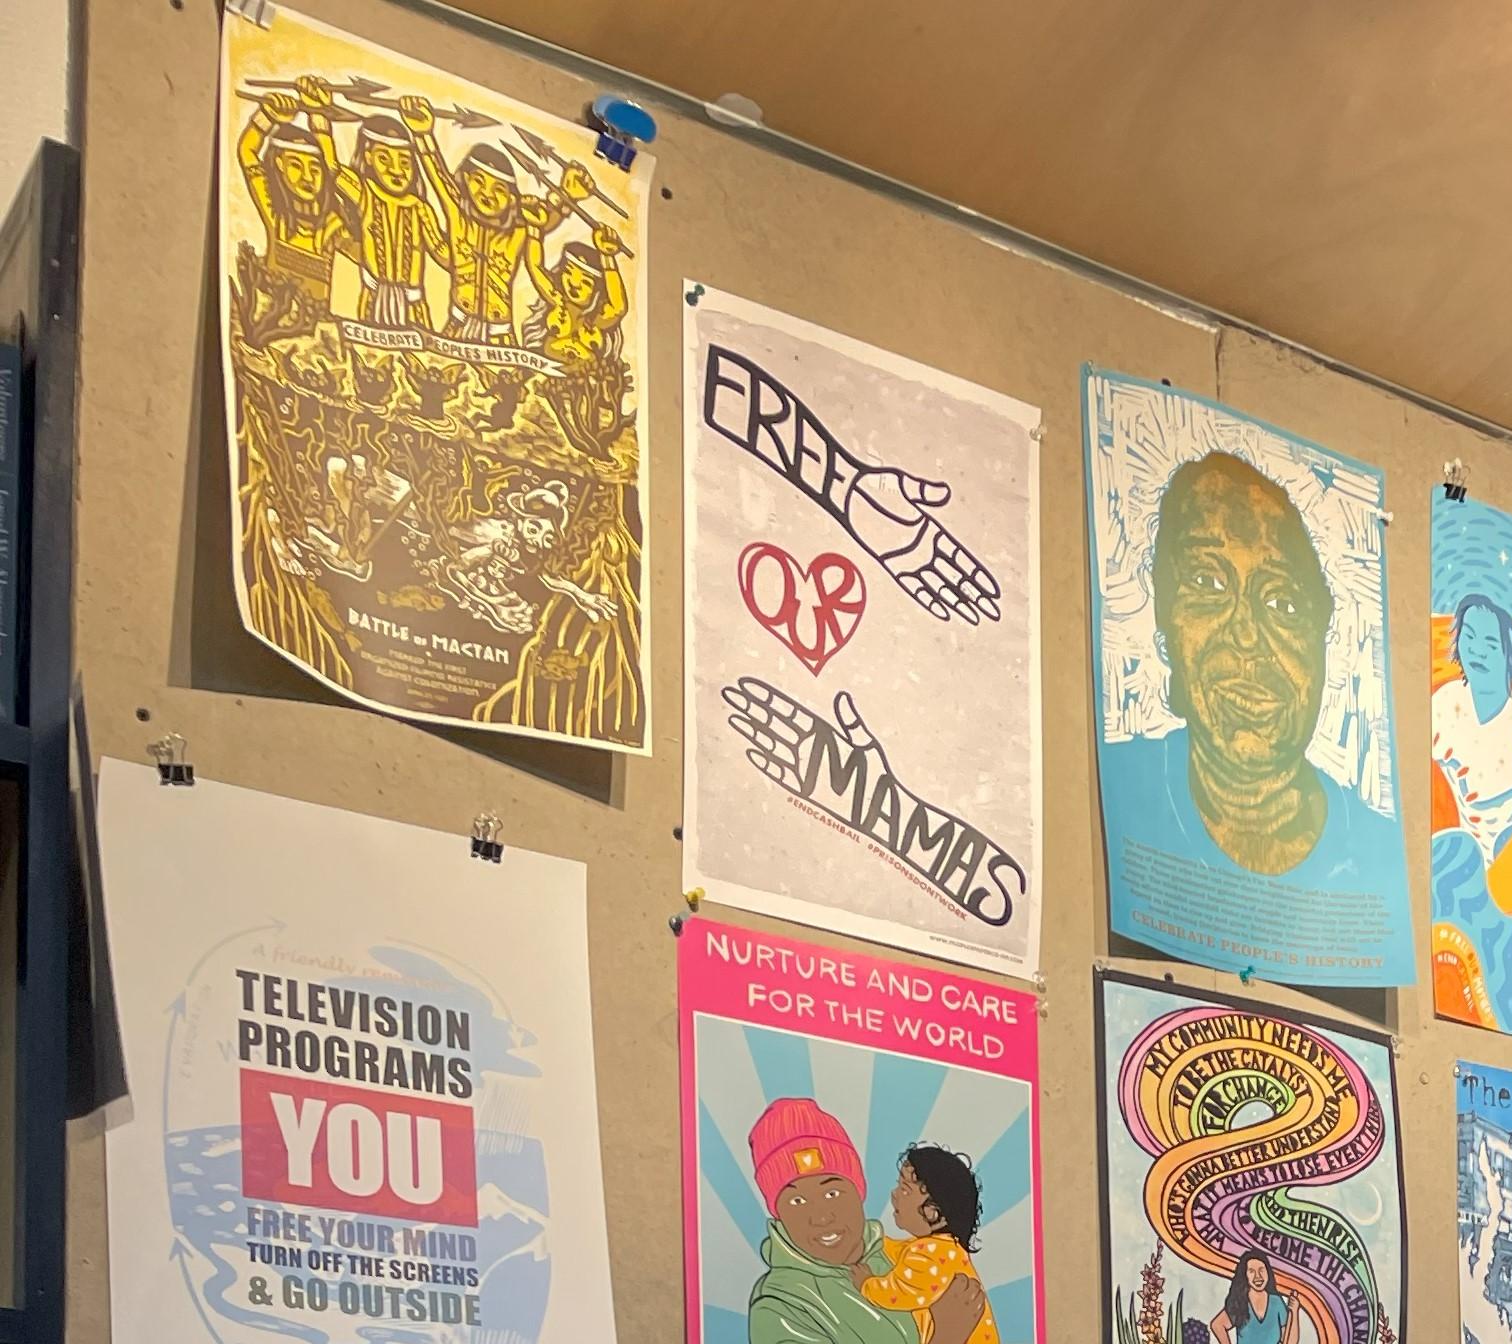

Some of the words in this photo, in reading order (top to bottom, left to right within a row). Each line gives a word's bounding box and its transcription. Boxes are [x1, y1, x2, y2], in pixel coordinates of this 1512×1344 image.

[704, 343, 867, 524] FREE
[348, 607, 409, 641] BATTLE
[432, 634, 509, 664] MACTAN
[739, 541, 867, 668] OUR
[801, 726, 1027, 928] MAMAS
[235, 969, 470, 1049] TELEVISION
[707, 933, 857, 988] NURTURE
[866, 966, 934, 1004] AND
[941, 984, 1018, 1025] CARE
[237, 1019, 473, 1099] PROGRAMS
[748, 984, 815, 1018] FOR
[823, 998, 883, 1033] THE
[893, 1008, 1005, 1060] WORLD
[1462, 1074, 1511, 1109] The
[269, 1092, 441, 1205] YOU
[247, 1208, 313, 1246] FREE
[319, 1215, 397, 1255] YOUR
[404, 1225, 477, 1262] MIND
[247, 1241, 302, 1269] TURN
[307, 1249, 346, 1274] OFF
[349, 1252, 385, 1279] THE
[390, 1257, 479, 1288] SCREENS
[247, 1277, 274, 1305] &
[282, 1279, 330, 1313] GO
[338, 1284, 482, 1327] OUTSIDE
